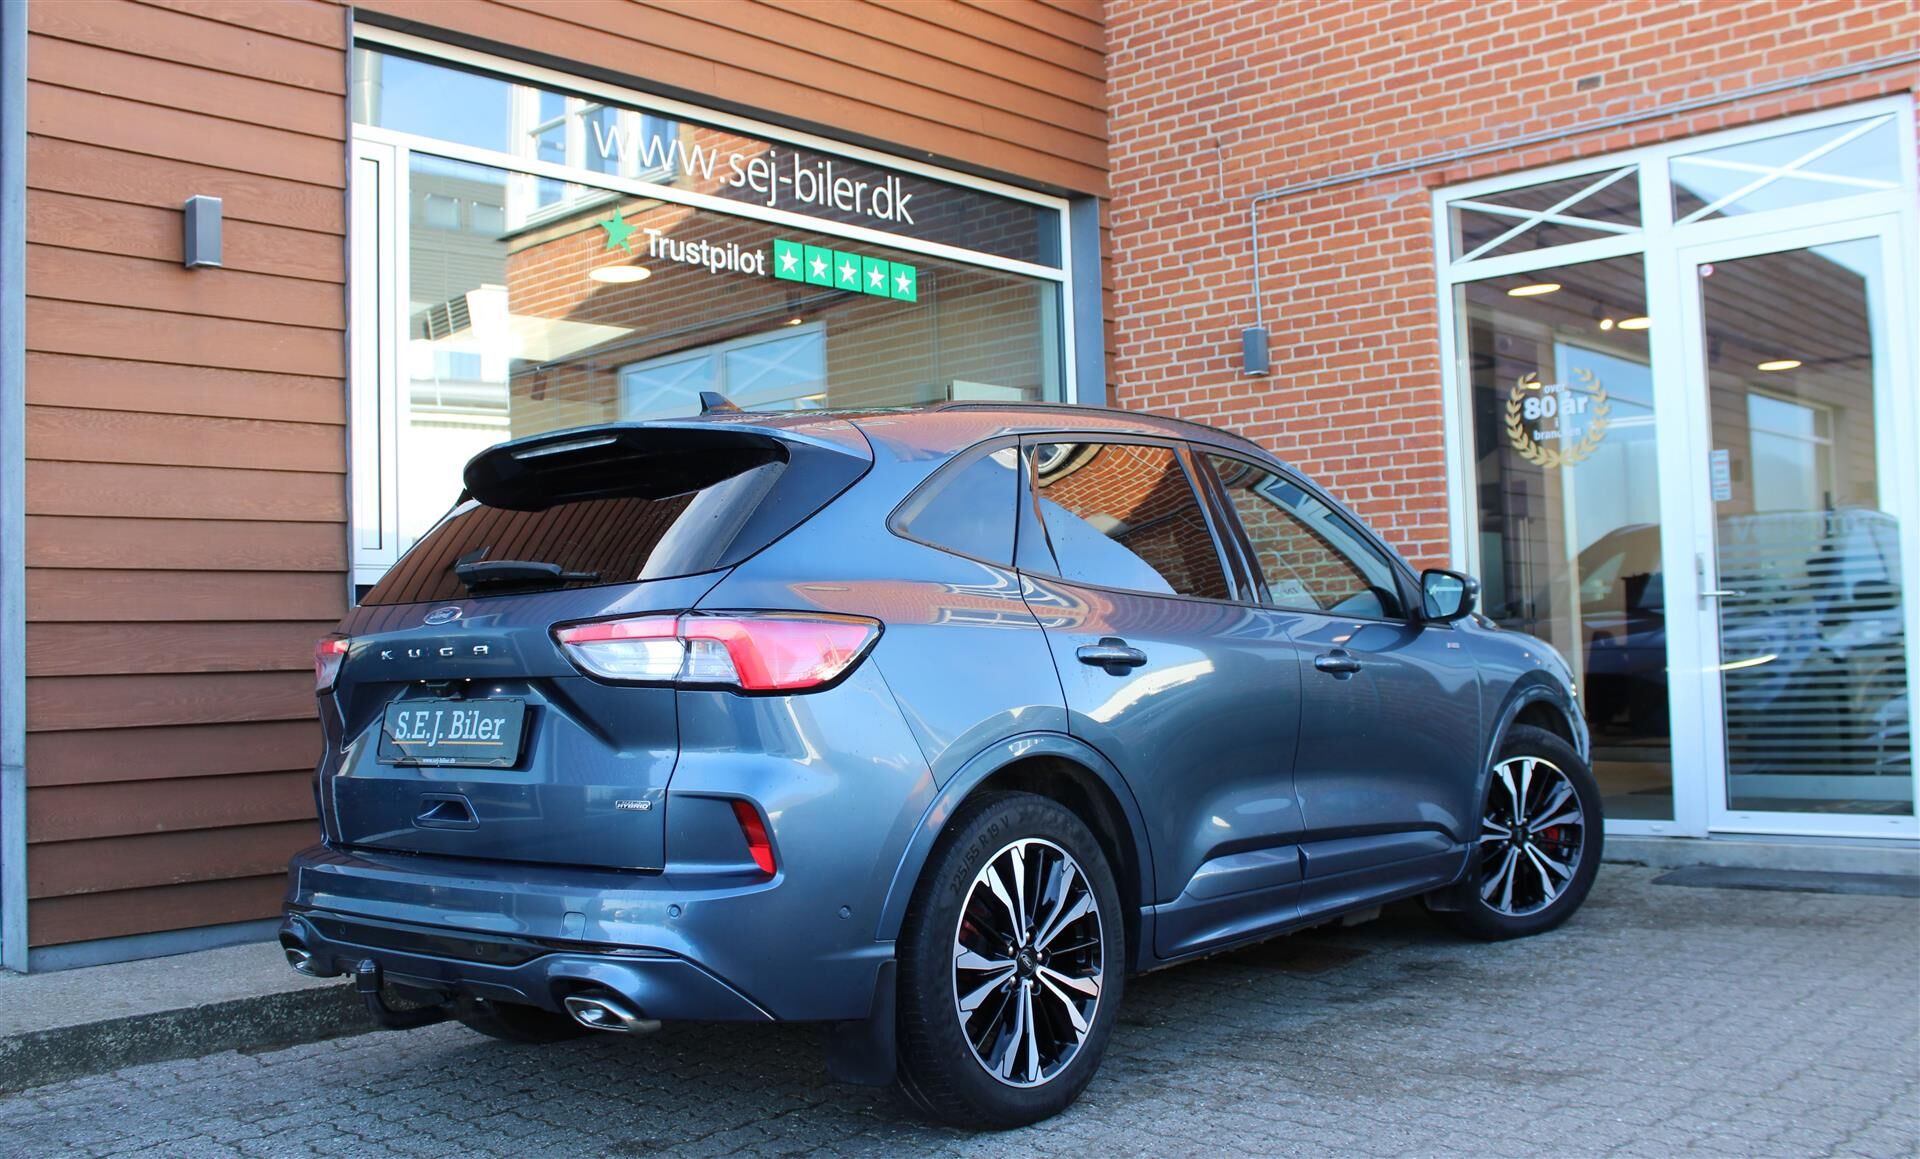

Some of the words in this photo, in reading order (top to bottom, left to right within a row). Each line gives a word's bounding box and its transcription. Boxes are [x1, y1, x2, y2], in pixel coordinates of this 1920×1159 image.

[593, 120, 915, 225] www.sej-biler.dk
[643, 227, 765, 276] Trustpilot
[1523, 395, 1557, 420] 80
[1560, 391, 1588, 415] år
[381, 645, 489, 660] KUGA
[395, 711, 443, 747] S.E.J.
[448, 710, 505, 740] Biler
[950, 845, 980, 895] 225/55
[978, 835, 988, 850] R
[987, 823, 1000, 839] 19
